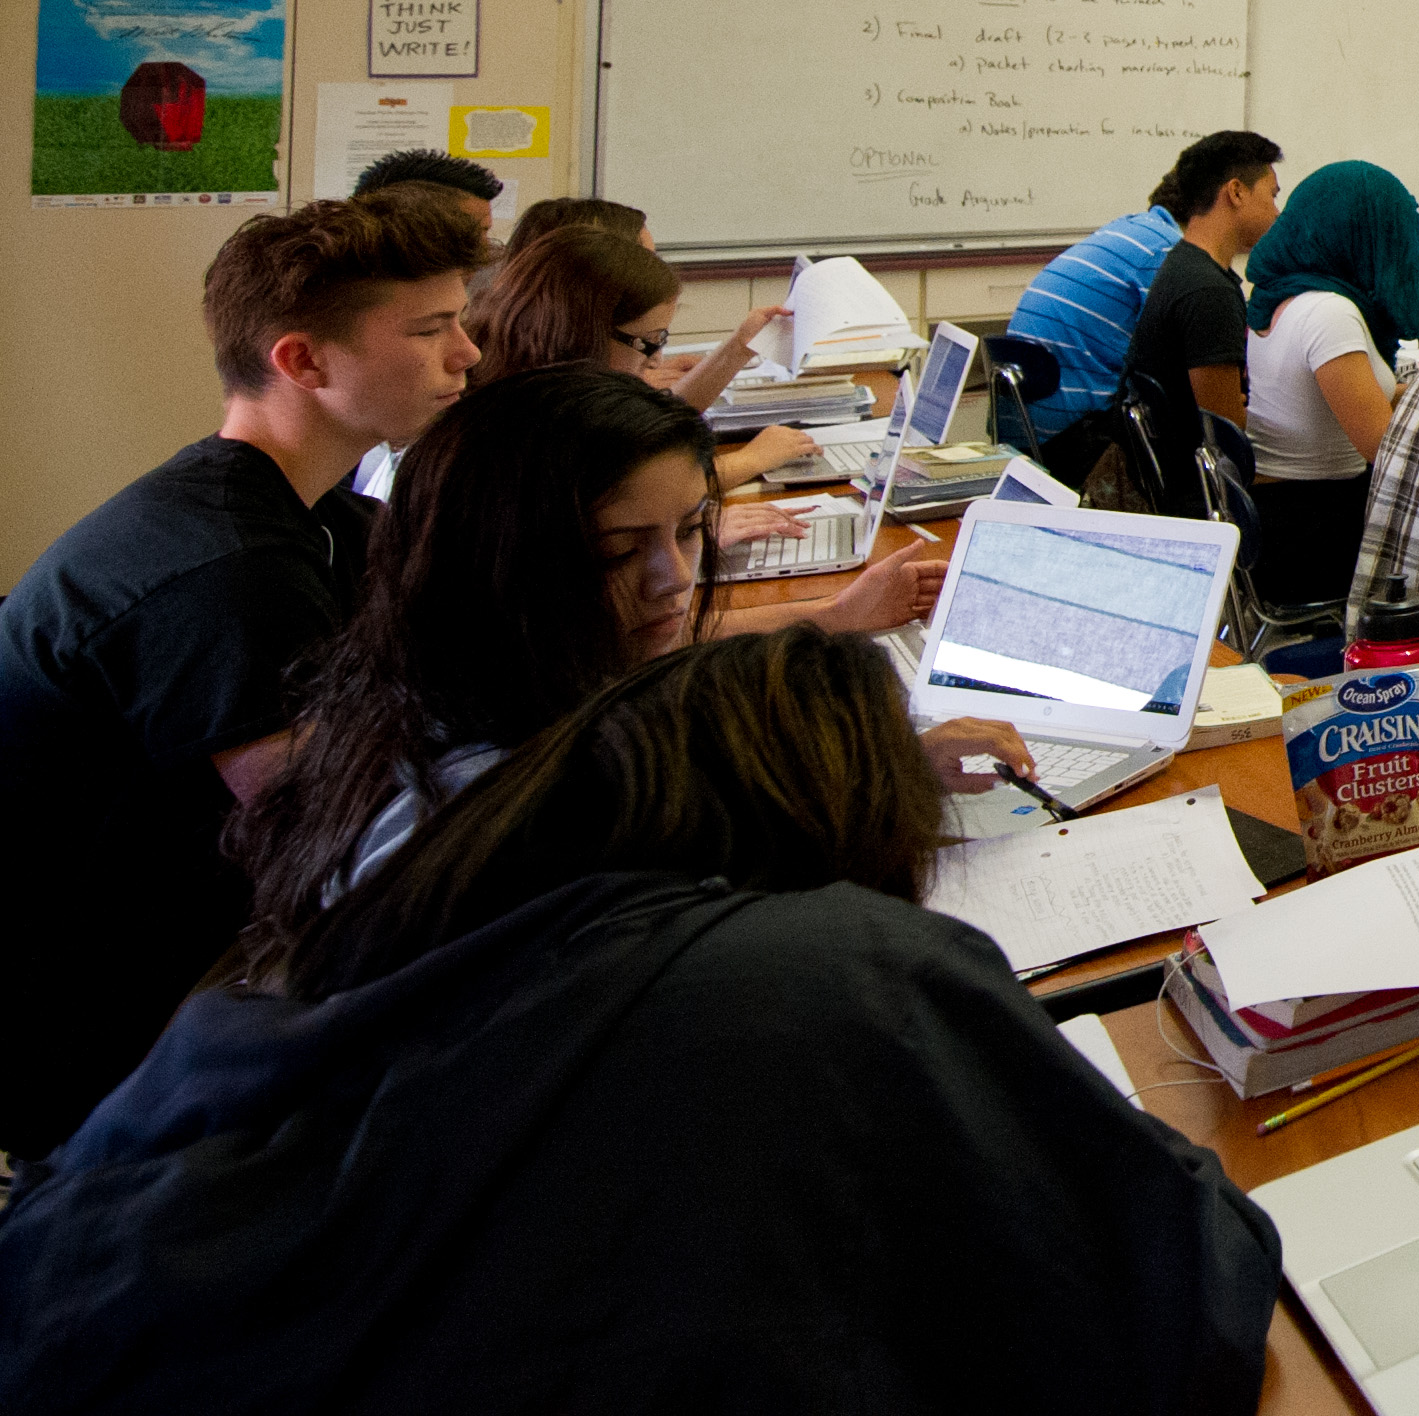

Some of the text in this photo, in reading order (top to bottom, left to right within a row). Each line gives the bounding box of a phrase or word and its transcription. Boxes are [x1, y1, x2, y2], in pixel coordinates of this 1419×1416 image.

[379, 1, 463, 18] THINK
[387, 19, 451, 35] JUST
[1342, 679, 1407, 705] Ocean Spray
[1352, 753, 1412, 782] Fruit
[1331, 830, 1392, 851] Cranberry
